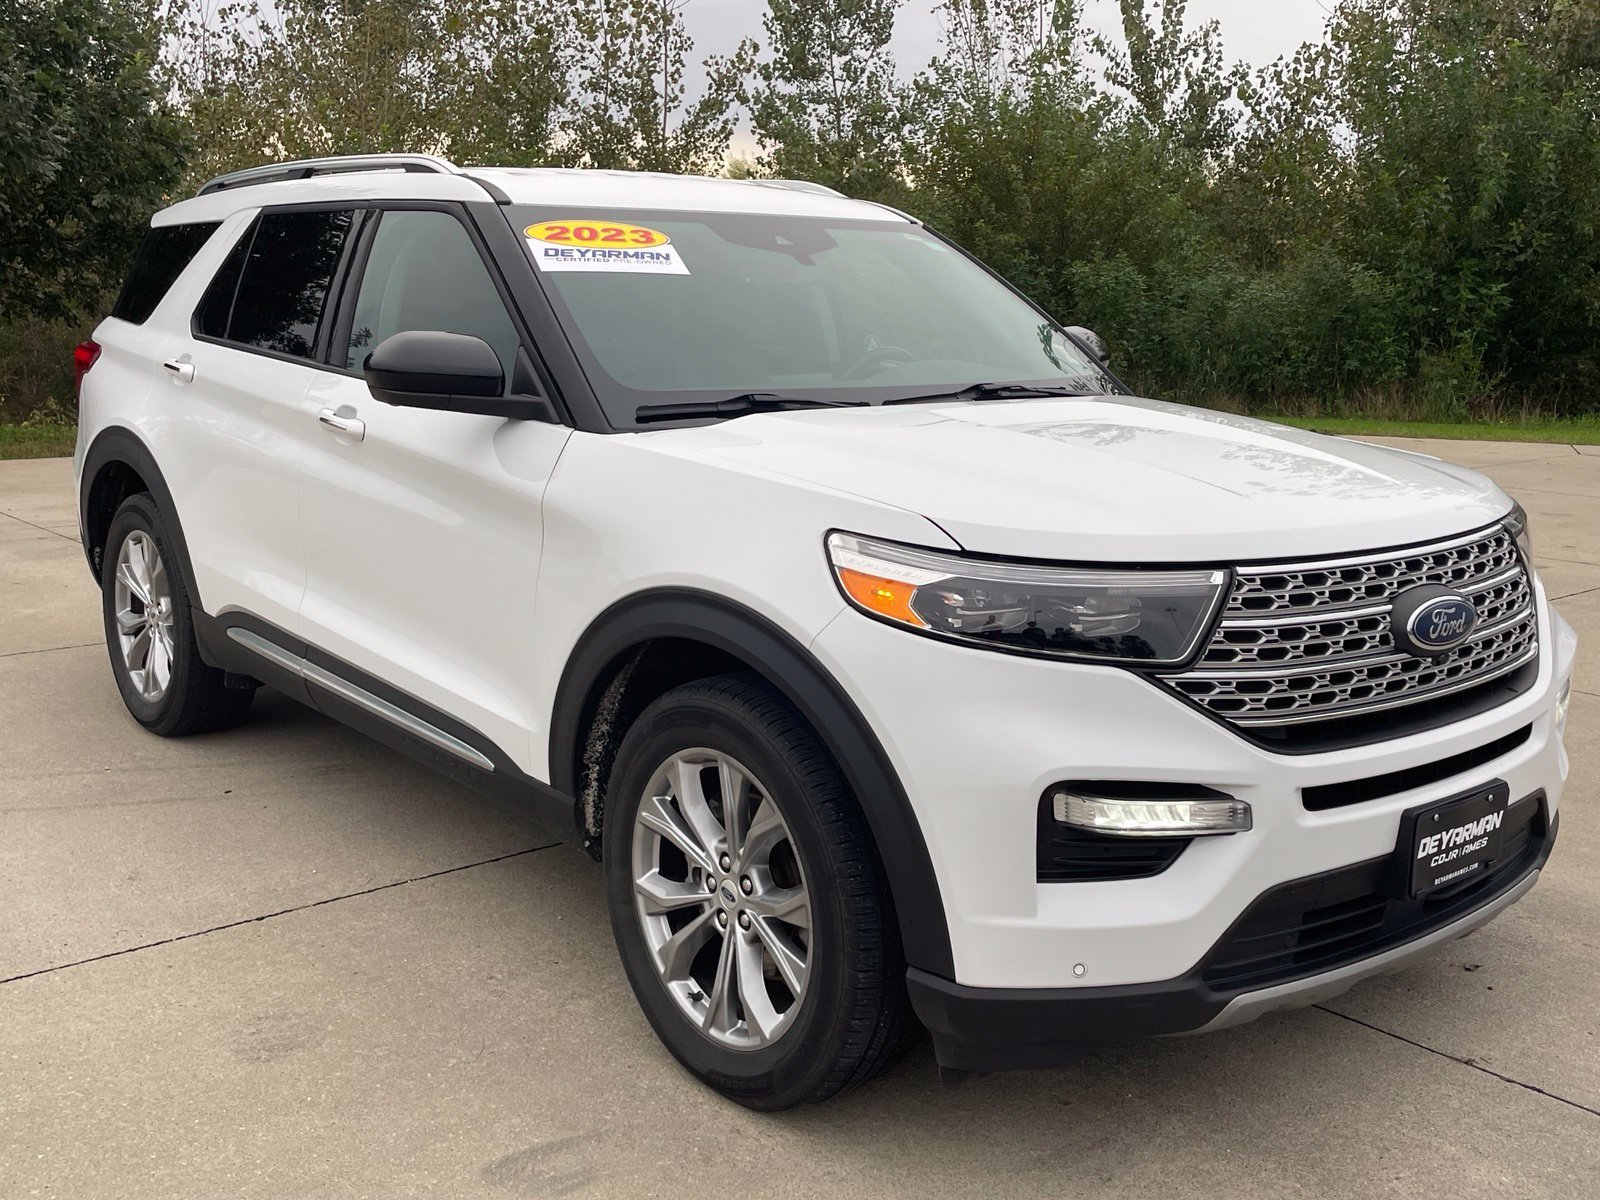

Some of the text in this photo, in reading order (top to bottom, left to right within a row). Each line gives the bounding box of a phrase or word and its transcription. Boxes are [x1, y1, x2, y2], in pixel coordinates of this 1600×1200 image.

[544, 225, 656, 244] 2023
[544, 248, 670, 260] DEYARMAN
[1429, 607, 1466, 639] Ford
[1417, 810, 1504, 859] DEYARMAN
[1462, 837, 1488, 855] AMES
